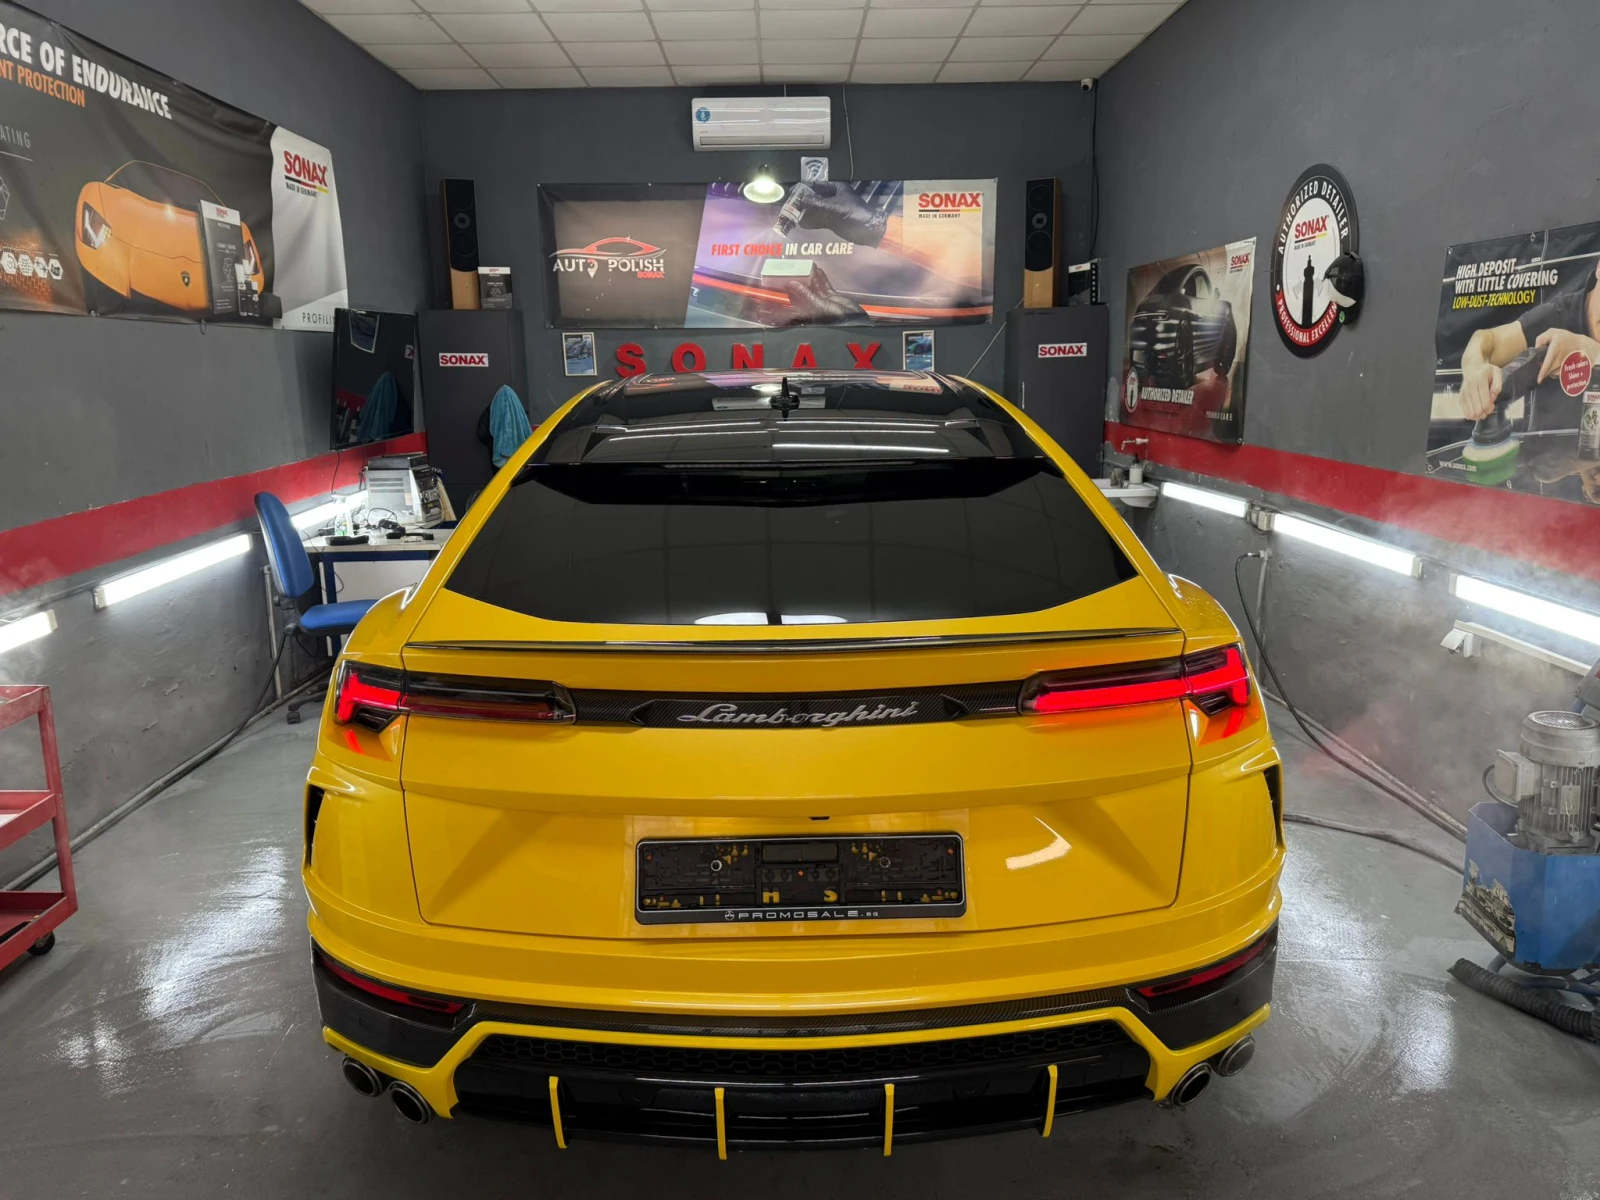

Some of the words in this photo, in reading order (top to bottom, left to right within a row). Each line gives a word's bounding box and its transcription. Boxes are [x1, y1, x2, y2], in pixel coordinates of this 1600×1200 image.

[17, 64, 85, 107] PROTECTION
[39, 41, 65, 76] OF
[72, 54, 172, 119] ENDURANCE
[284, 150, 328, 187] SONAX
[918, 193, 981, 208] SONAX
[1278, 181, 1319, 255] AUTHORIZED
[1321, 181, 1349, 240] DETAILER
[1295, 214, 1328, 239] SONAX
[711, 244, 740, 256] FIRST
[743, 243, 784, 256] CHOICE
[785, 243, 798, 256] IN
[801, 243, 822, 255] CAR
[825, 242, 854, 255] CARE
[608, 258, 665, 272] POLISH
[1456, 263, 1478, 279] HIGH
[1479, 258, 1516, 276] DEPOSIT
[1455, 278, 1475, 294] WITH
[1477, 275, 1506, 292] LITTLE
[1507, 269, 1558, 289] COVERING
[1452, 289, 1536, 309] LOW-DUST-TECHNOLOGY
[1277, 299, 1310, 343] PROFESSIONAL
[1311, 302, 1337, 341] EXCELLEN
[440, 354, 486, 365] SONAX
[615, 342, 881, 377] SONAX
[1039, 344, 1084, 356] SONAX
[1565, 362, 1576, 371] Fresh
[1568, 372, 1580, 380] Shine
[1141, 386, 1171, 402] AUTHORIZED
[1171, 389, 1194, 405] DETAILER
[1567, 380, 1587, 391] protection
[677, 702, 919, 727] Lamborghini
